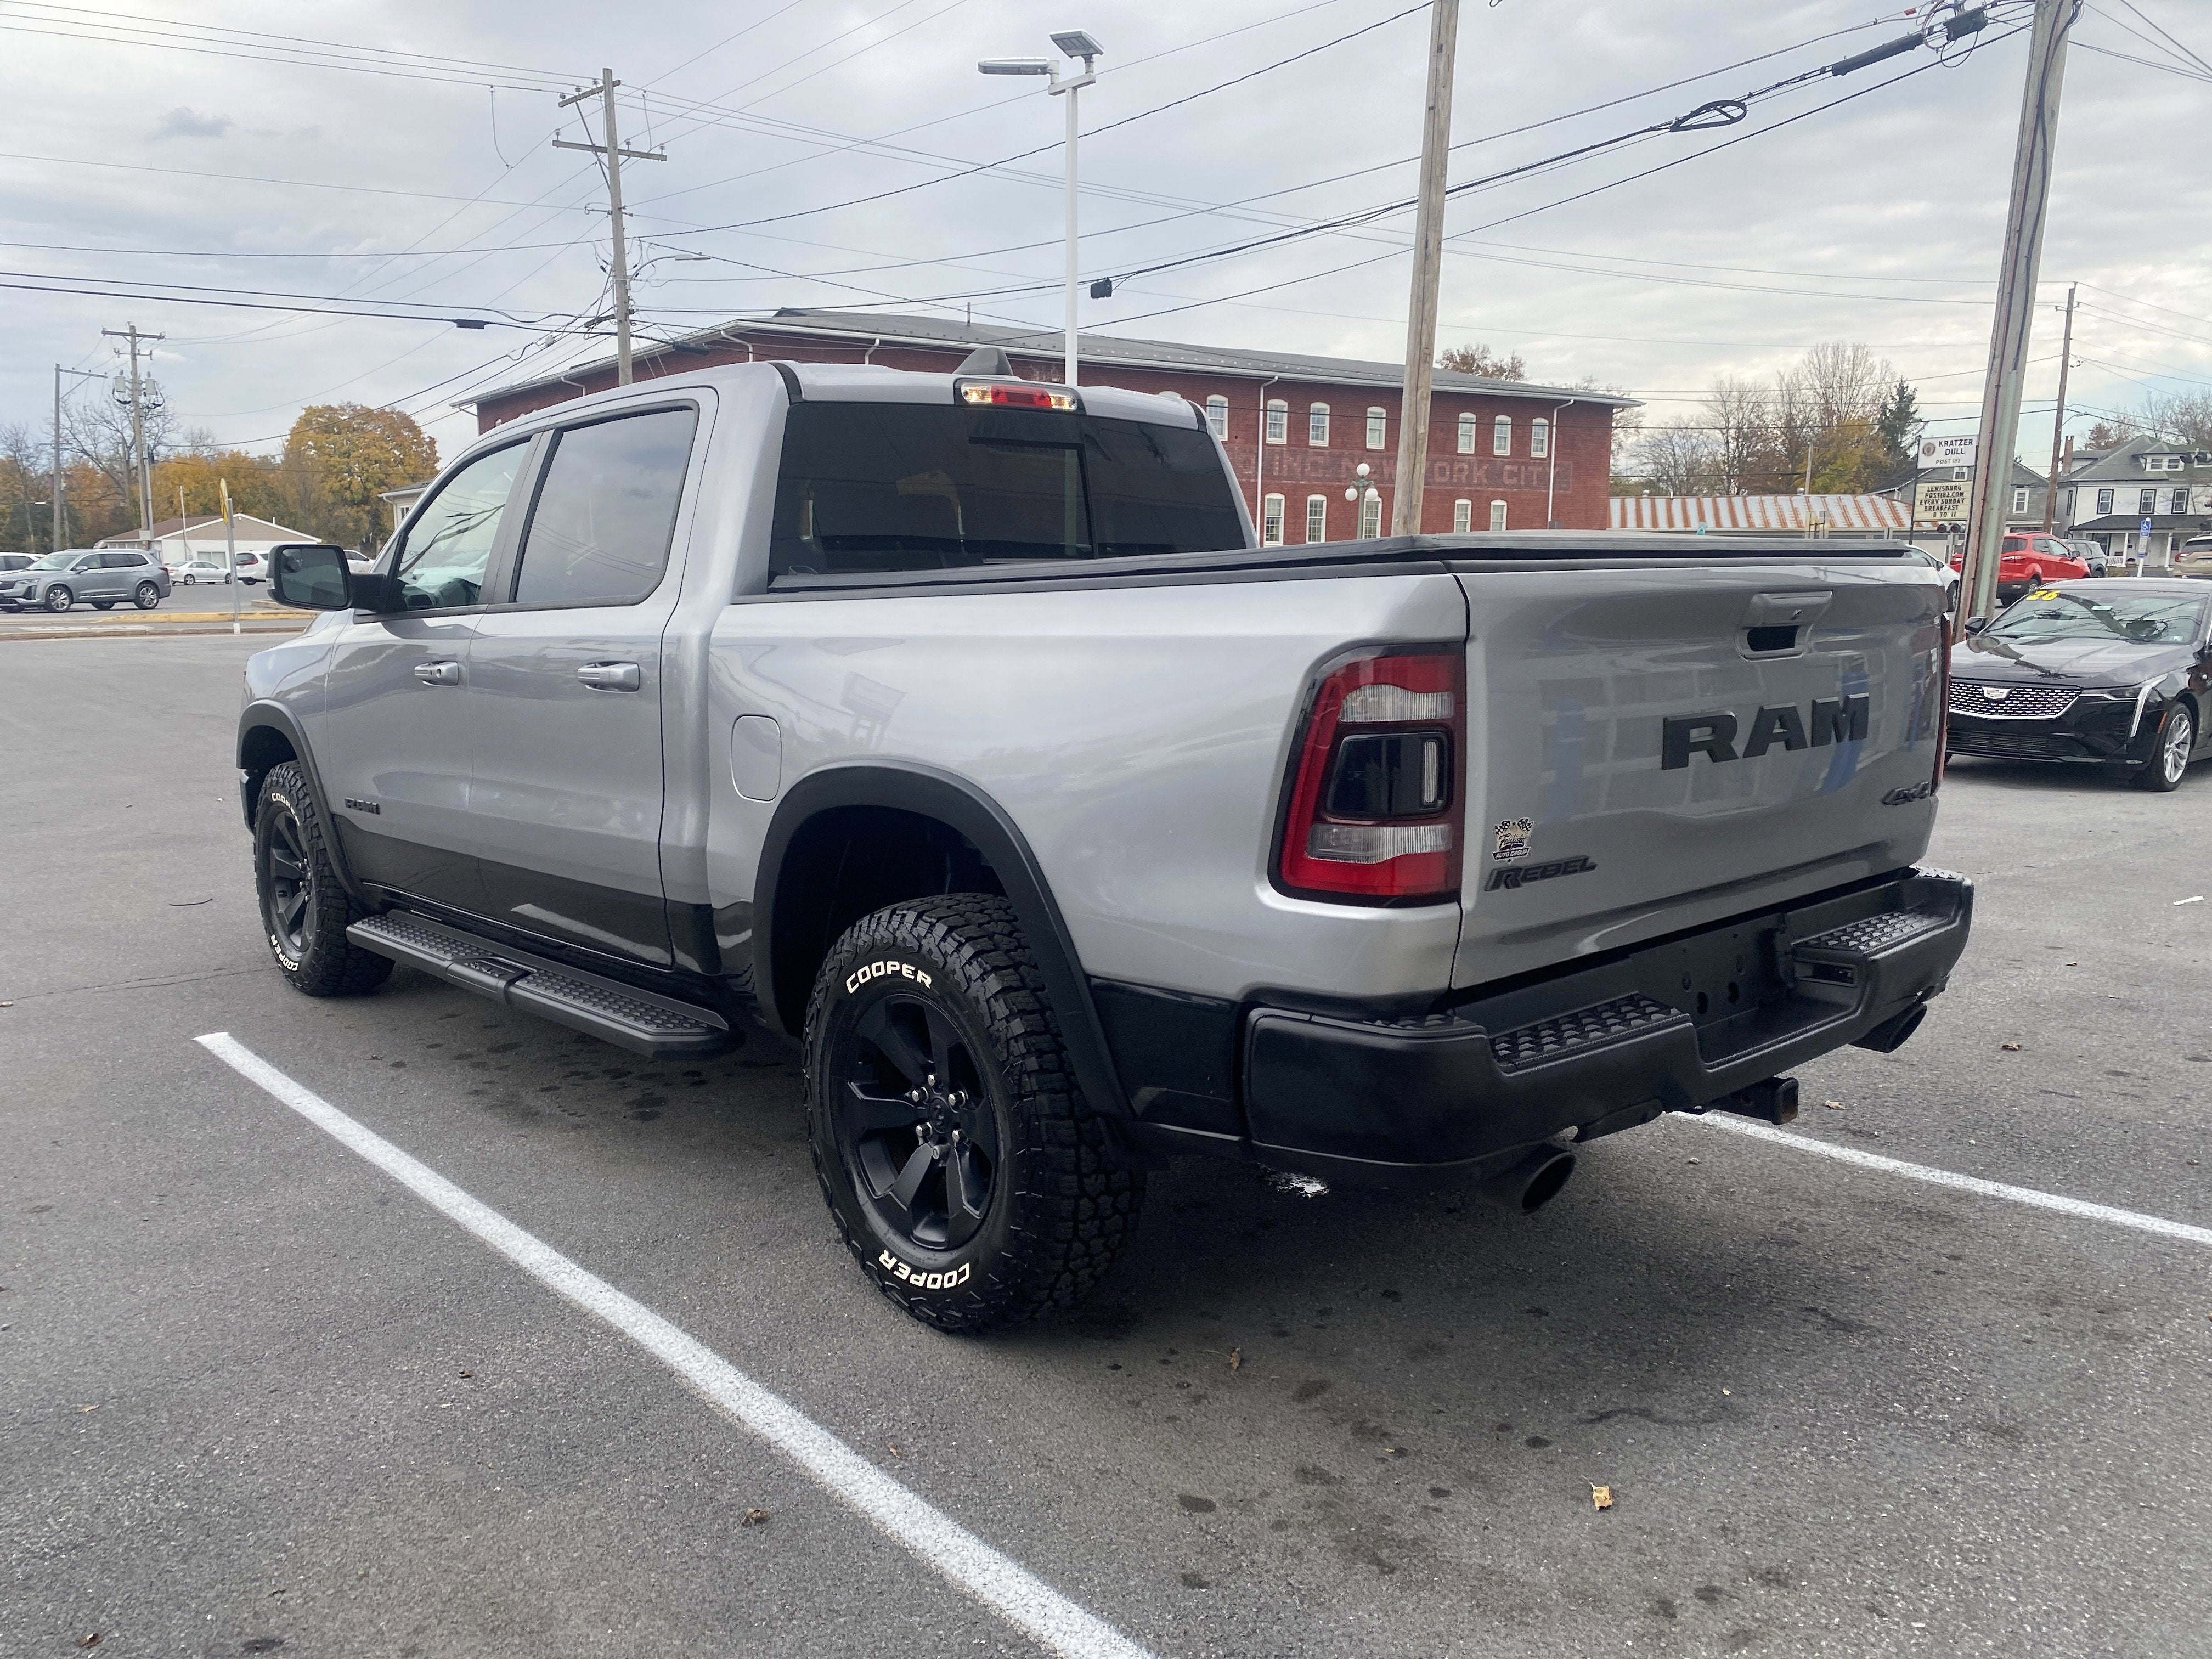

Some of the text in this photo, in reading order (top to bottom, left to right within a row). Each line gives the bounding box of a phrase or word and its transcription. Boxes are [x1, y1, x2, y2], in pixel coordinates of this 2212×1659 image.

[1939, 438, 1973, 447] KRATZER
[1426, 461, 1489, 484] ORK
[2025, 590, 2061, 601] 26
[1662, 692, 1870, 770] RAM
[1484, 855, 1598, 891] REBEL
[270, 934, 299, 972] COOPER
[846, 961, 932, 994] COOPER
[879, 1249, 970, 1289] COOPER
